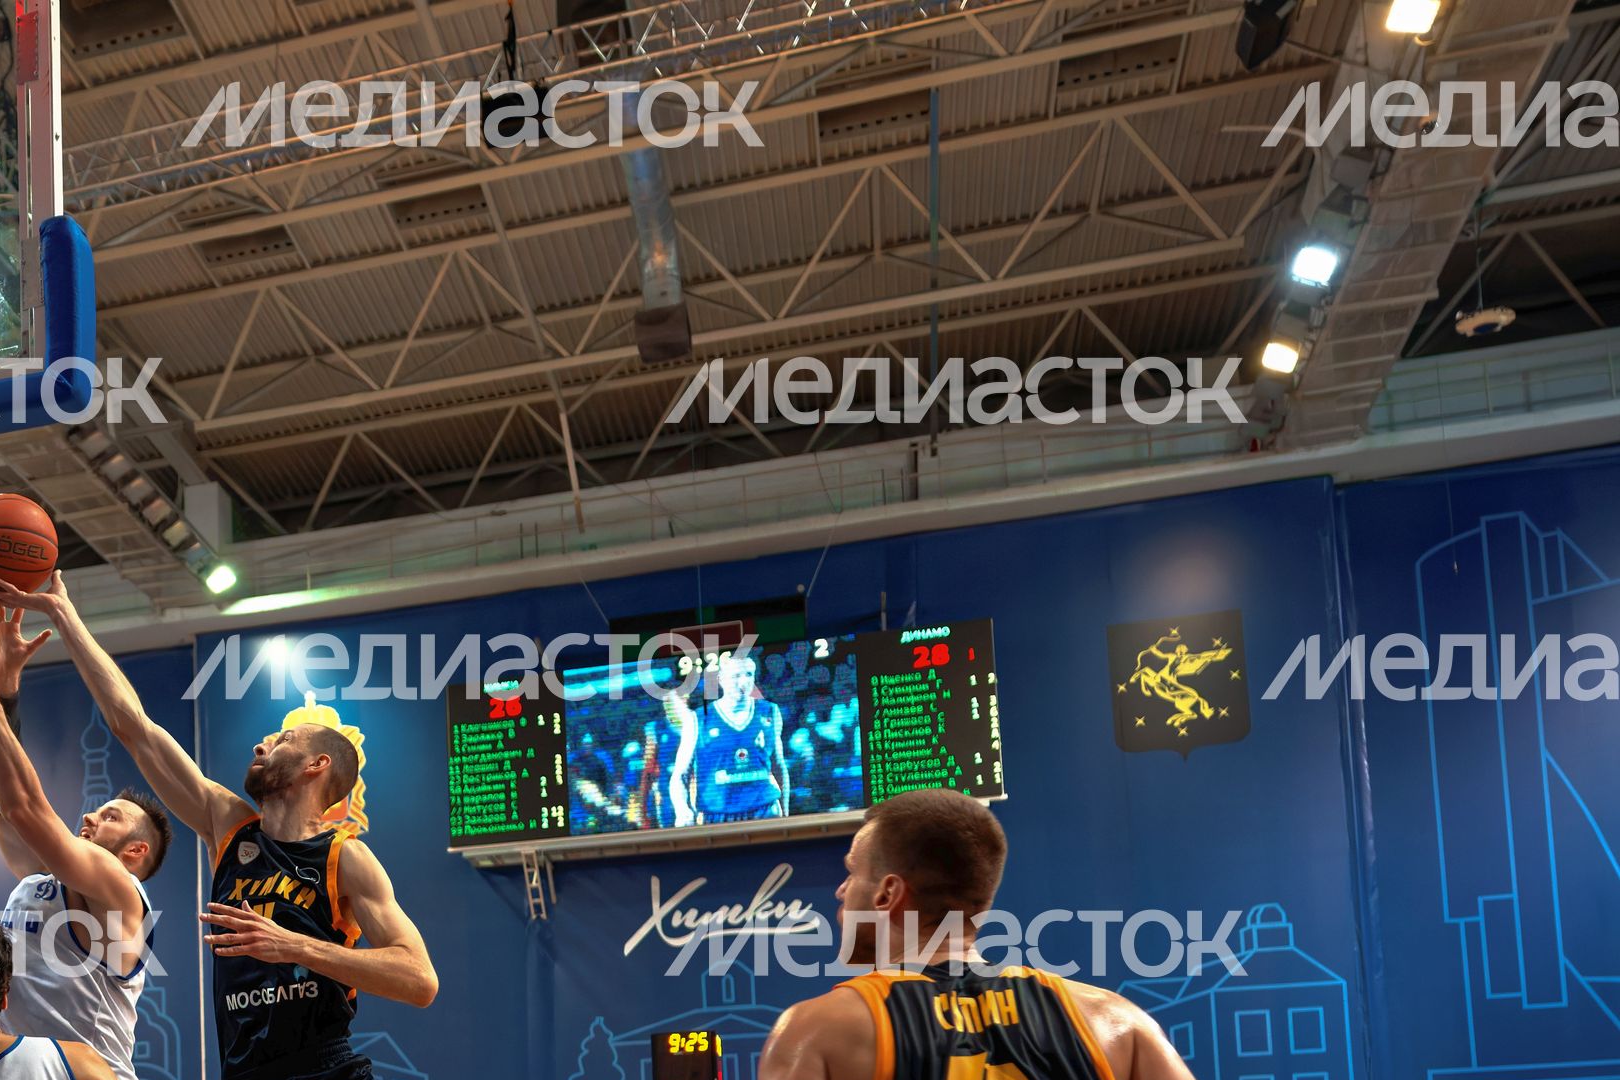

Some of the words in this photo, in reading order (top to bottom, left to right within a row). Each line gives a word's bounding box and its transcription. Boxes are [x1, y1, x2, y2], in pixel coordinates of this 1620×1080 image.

[900, 626, 951, 644] ДИНАМО
[813, 638, 830, 659] 2
[913, 643, 950, 669] 28
[669, 1031, 709, 1054] 9:25
